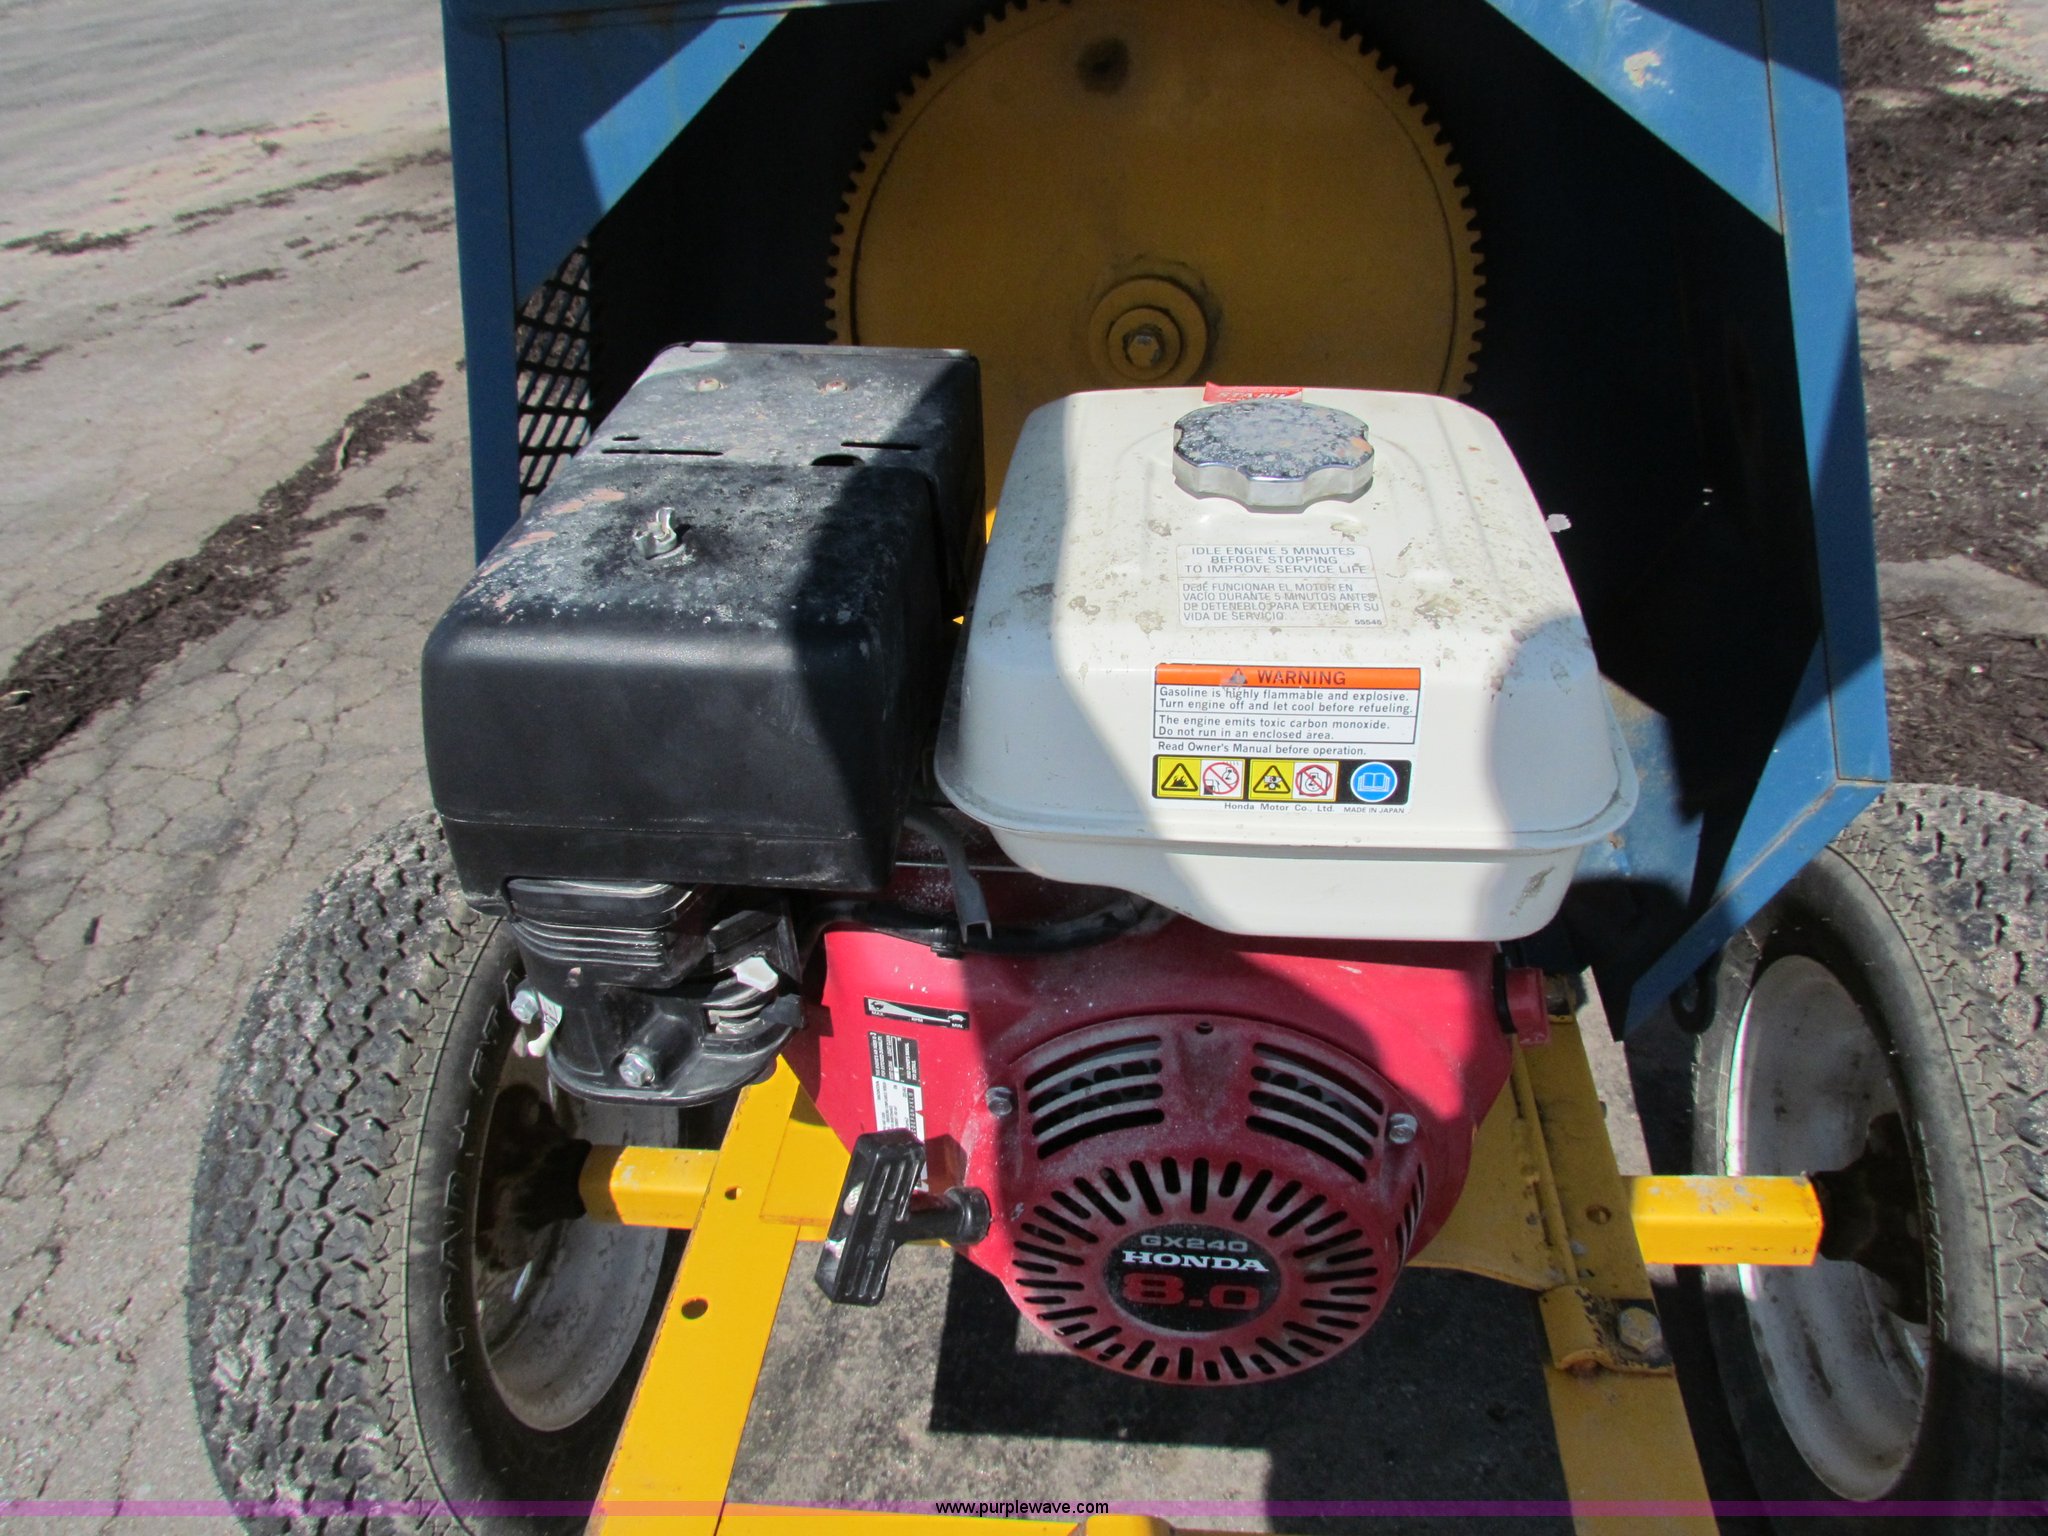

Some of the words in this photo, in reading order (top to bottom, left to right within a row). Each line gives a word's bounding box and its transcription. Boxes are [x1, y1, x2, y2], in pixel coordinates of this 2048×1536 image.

[1191, 547, 1221, 555] IDLE
[1226, 547, 1277, 555] ENGINE
[1280, 547, 1289, 555] 5
[1293, 547, 1355, 556] MINUTES
[1211, 556, 1263, 564] BEFORE
[1268, 556, 1338, 564] STOPPING
[1184, 565, 1202, 573] TO
[1207, 565, 1271, 573] IMPROVE
[1275, 565, 1336, 574] SERVICE
[1339, 566, 1367, 574] LIFE
[1211, 583, 1276, 591] FUNCIONAR
[1279, 583, 1293, 592] EL
[1295, 583, 1336, 592] MOTOR
[1339, 583, 1353, 592] EN
[1219, 592, 1271, 601] DURANTE
[1274, 592, 1281, 601] 5
[1284, 593, 1337, 601] MINUTOS
[1339, 593, 1375, 602] ANTES
[1270, 602, 1299, 611] PARA
[1303, 603, 1360, 611] EXTENDER
[1364, 603, 1379, 611] SU
[1184, 612, 1210, 621] VIDA
[1213, 612, 1227, 620] DE
[1257, 670, 1346, 685] WARNING
[1160, 687, 1208, 698] Gasoline
[1211, 688, 1221, 698] is
[1224, 688, 1259, 701] highly
[1263, 690, 1324, 701] flammable
[1328, 691, 1349, 701] and
[1352, 692, 1409, 703] explosive.
[1160, 698, 1185, 708] Turn
[1188, 700, 1227, 711] engine
[1230, 700, 1245, 710] off
[1248, 701, 1269, 711] and
[1273, 701, 1288, 711] let
[1291, 702, 1315, 712] cool
[1318, 703, 1355, 712] before
[1359, 703, 1413, 715] refueling.
[1159, 716, 1180, 726] The
[1183, 717, 1221, 728] engine
[1224, 718, 1256, 728] emits
[1260, 719, 1286, 728] toxic
[1290, 719, 1328, 729] carbon
[1332, 720, 1390, 730] monoxide.
[1159, 727, 1174, 737] Do
[1177, 728, 1195, 737] not
[1198, 729, 1217, 737] run
[1221, 728, 1232, 737] in
[1235, 730, 1249, 738] an
[1253, 729, 1303, 739] enclosed
[1306, 732, 1334, 740] area.
[1158, 741, 1185, 751] Read
[1187, 742, 1230, 752] Owner's
[1233, 743, 1272, 753] Manual
[1275, 744, 1310, 754] before
[1313, 745, 1366, 756] operation.
[1140, 1235, 1248, 1253] GX240
[1122, 1250, 1270, 1272] HONDA
[1122, 1273, 1260, 1310] 8.0
